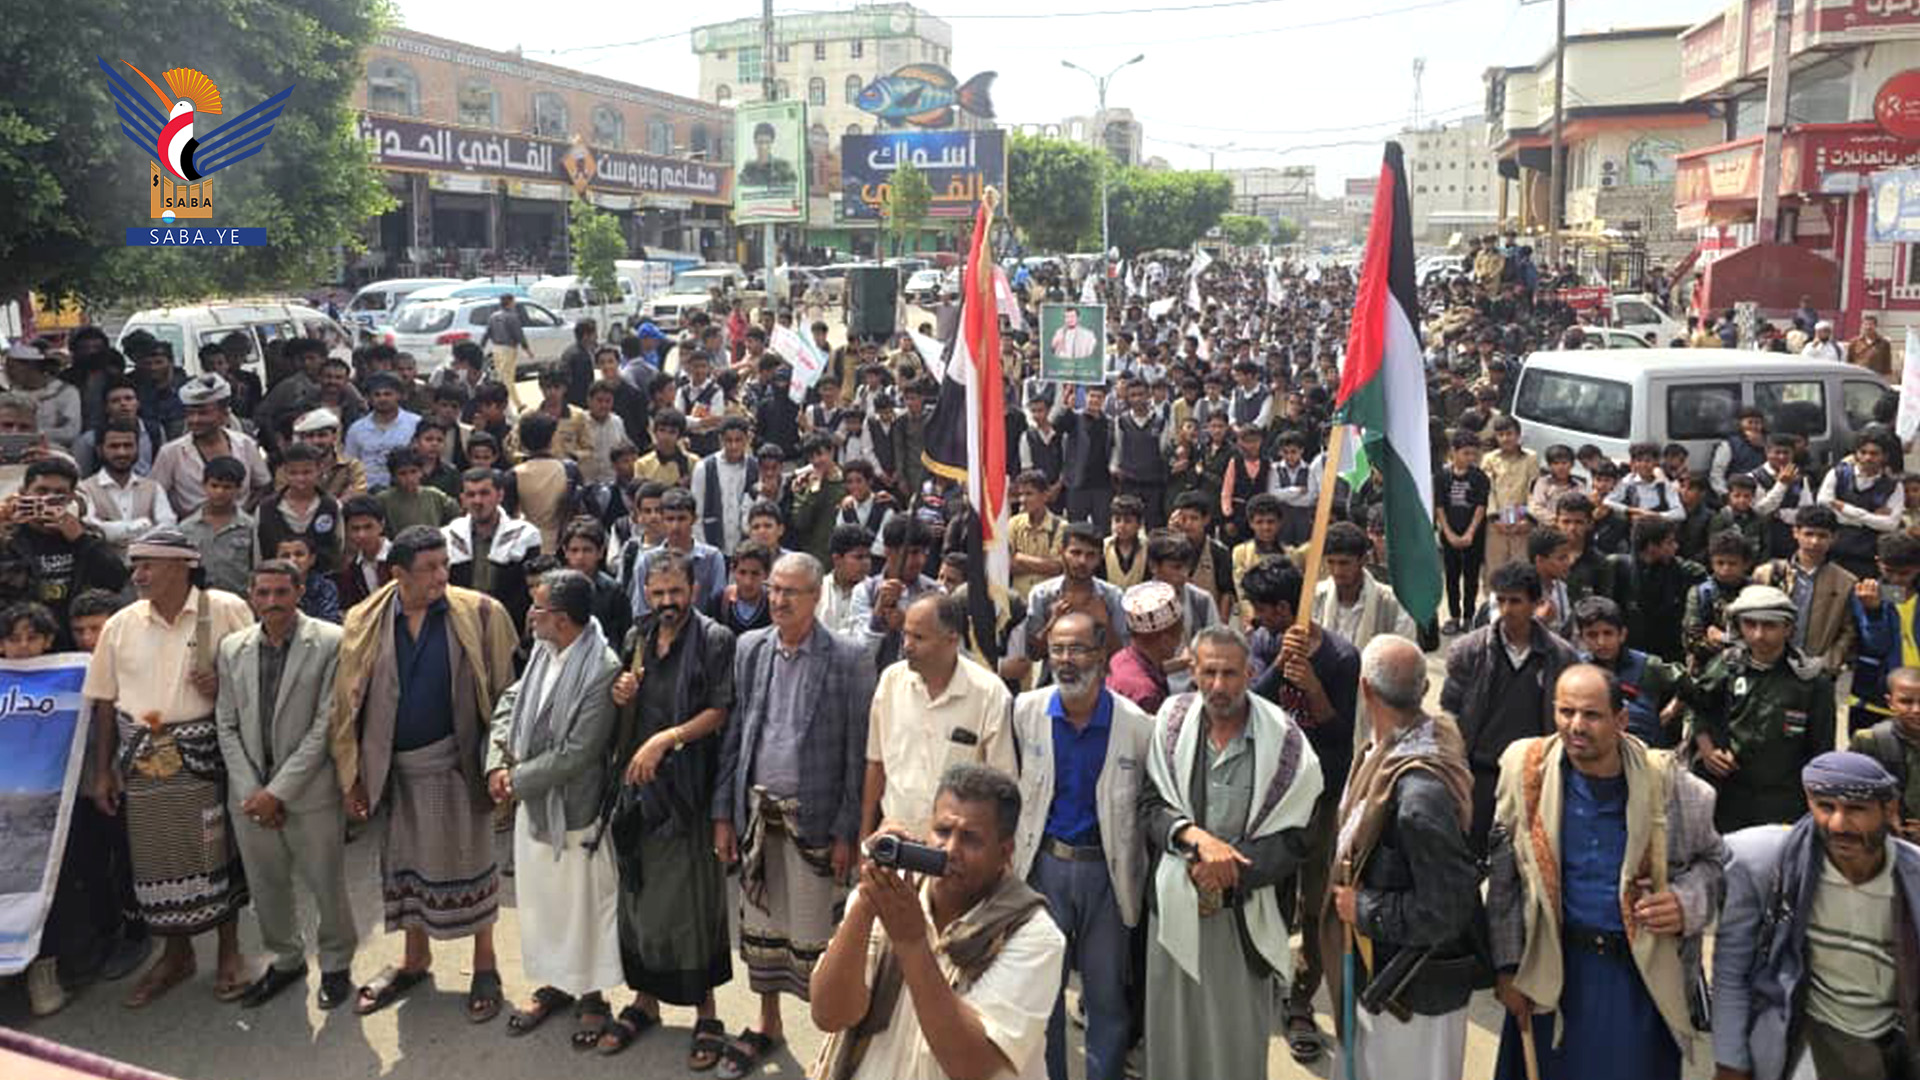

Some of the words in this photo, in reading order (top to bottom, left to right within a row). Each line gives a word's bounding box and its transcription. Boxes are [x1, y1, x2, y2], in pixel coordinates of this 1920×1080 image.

[355, 116, 451, 163] الحديث
[458, 135, 552, 173] القاضي
[597, 154, 658, 191] وبروست
[661, 165, 717, 191] مطاعم
